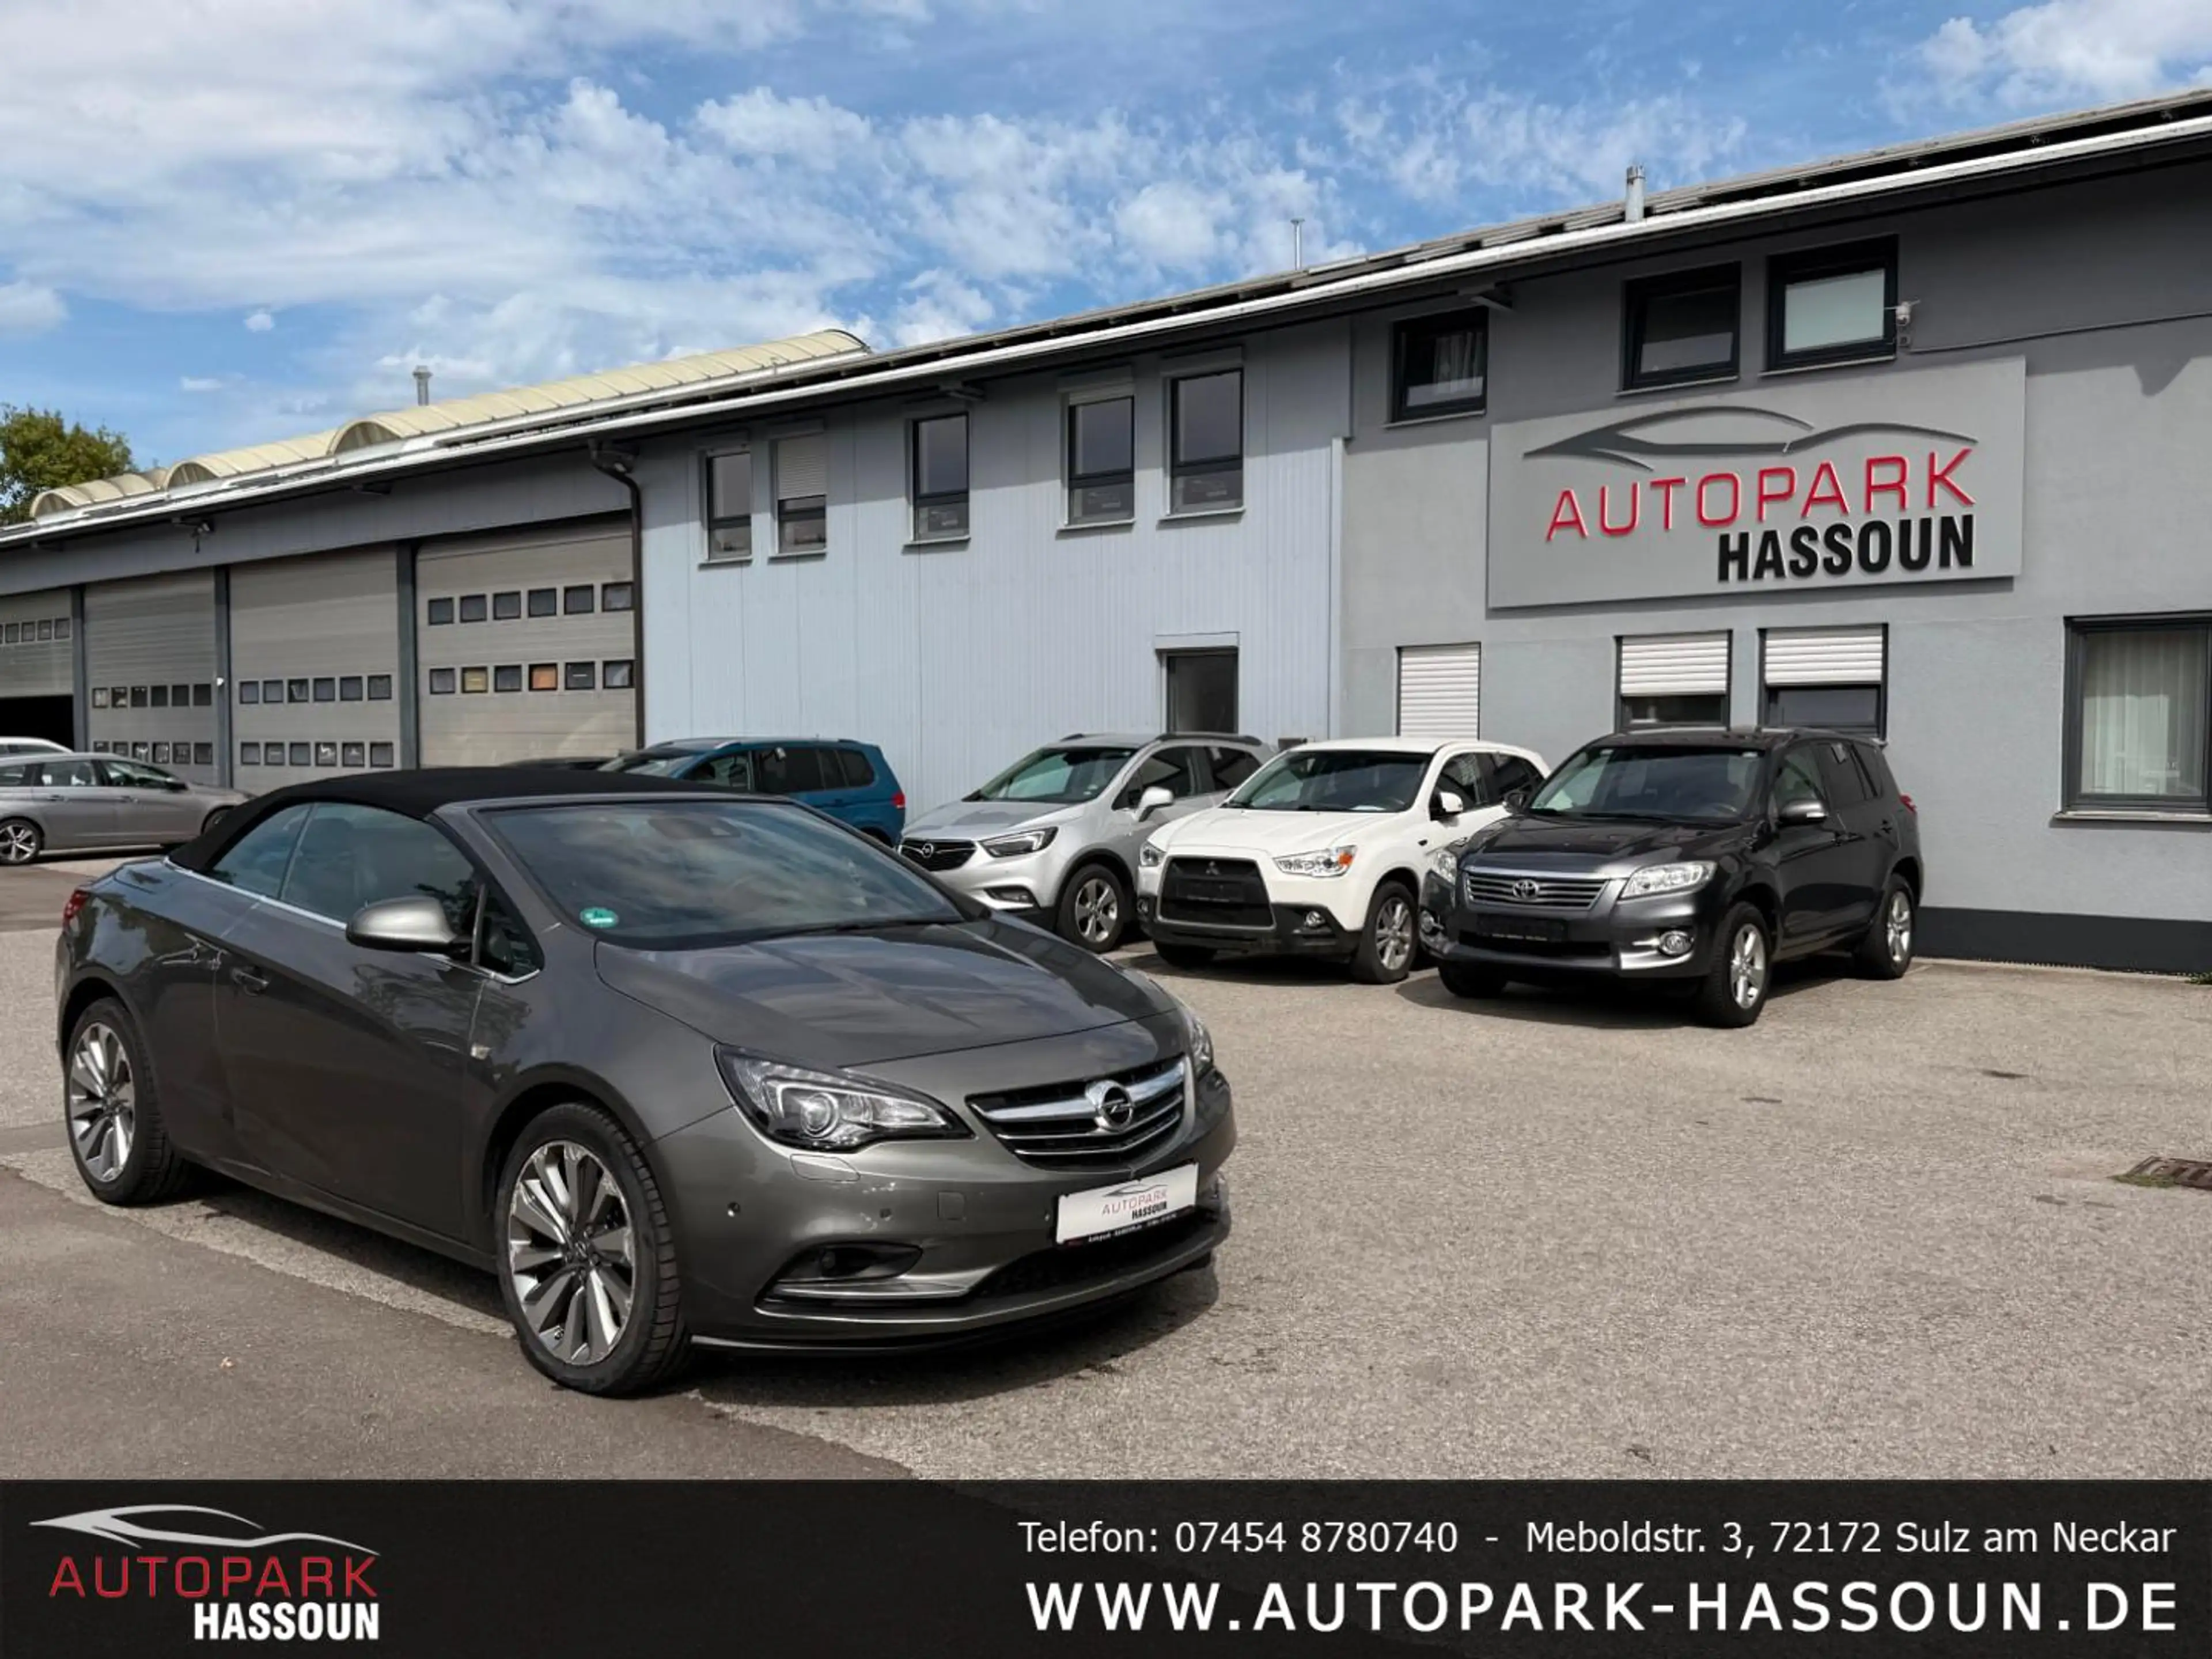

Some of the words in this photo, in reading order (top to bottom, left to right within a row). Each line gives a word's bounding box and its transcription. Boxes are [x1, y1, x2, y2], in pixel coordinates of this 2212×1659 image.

[1547, 448, 1976, 541] AUTOPARK
[1718, 514, 1975, 582] HASSOUN
[1101, 1189, 1168, 1216] AUTOPARK
